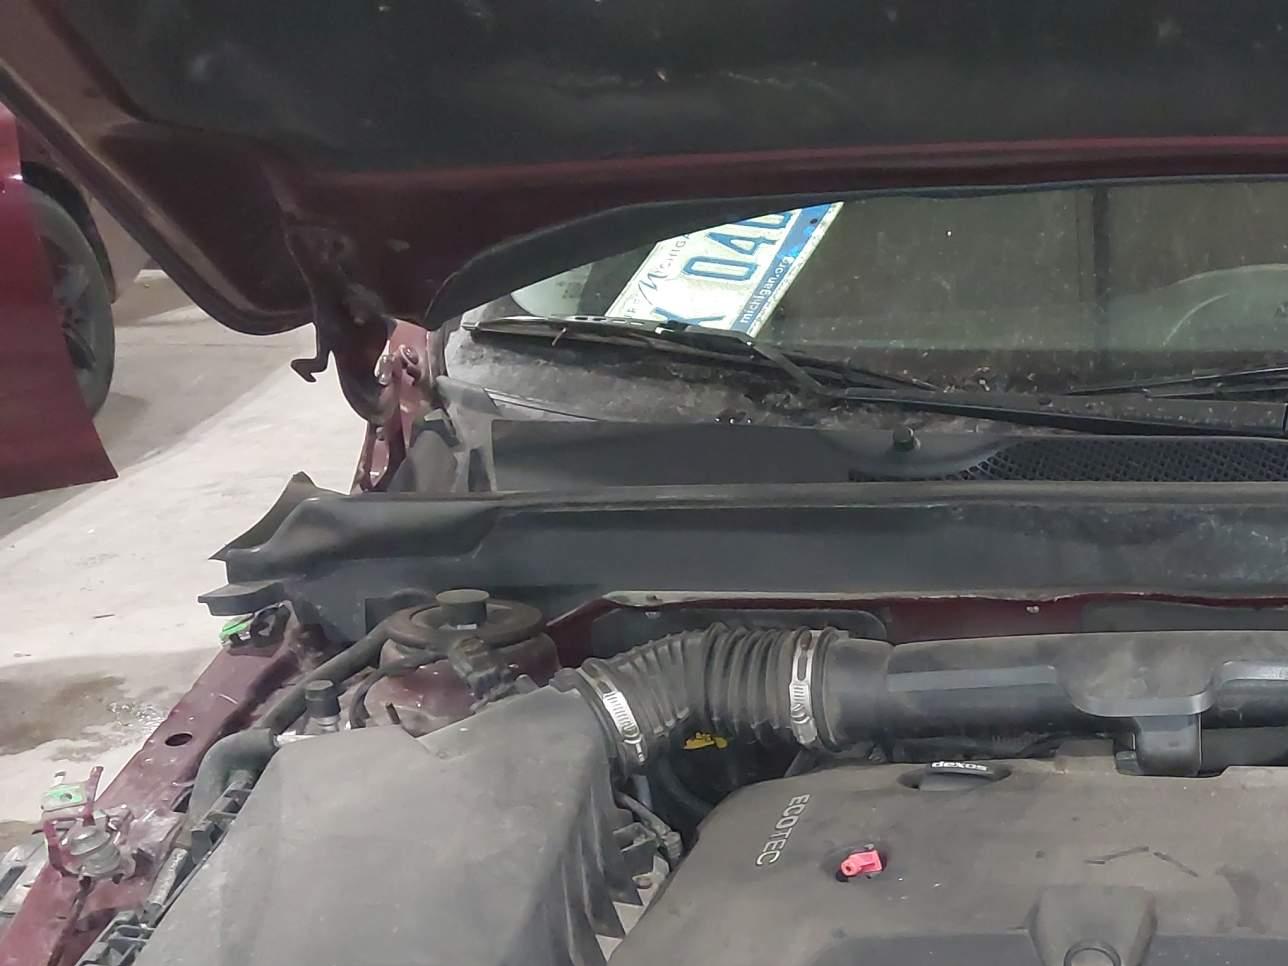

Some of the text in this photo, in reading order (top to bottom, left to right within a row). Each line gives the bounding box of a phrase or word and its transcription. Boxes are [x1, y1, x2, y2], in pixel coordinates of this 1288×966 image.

[740, 256, 795, 324] michigan.org
[931, 761, 987, 771] dexos
[756, 793, 810, 866] ECOTEC
